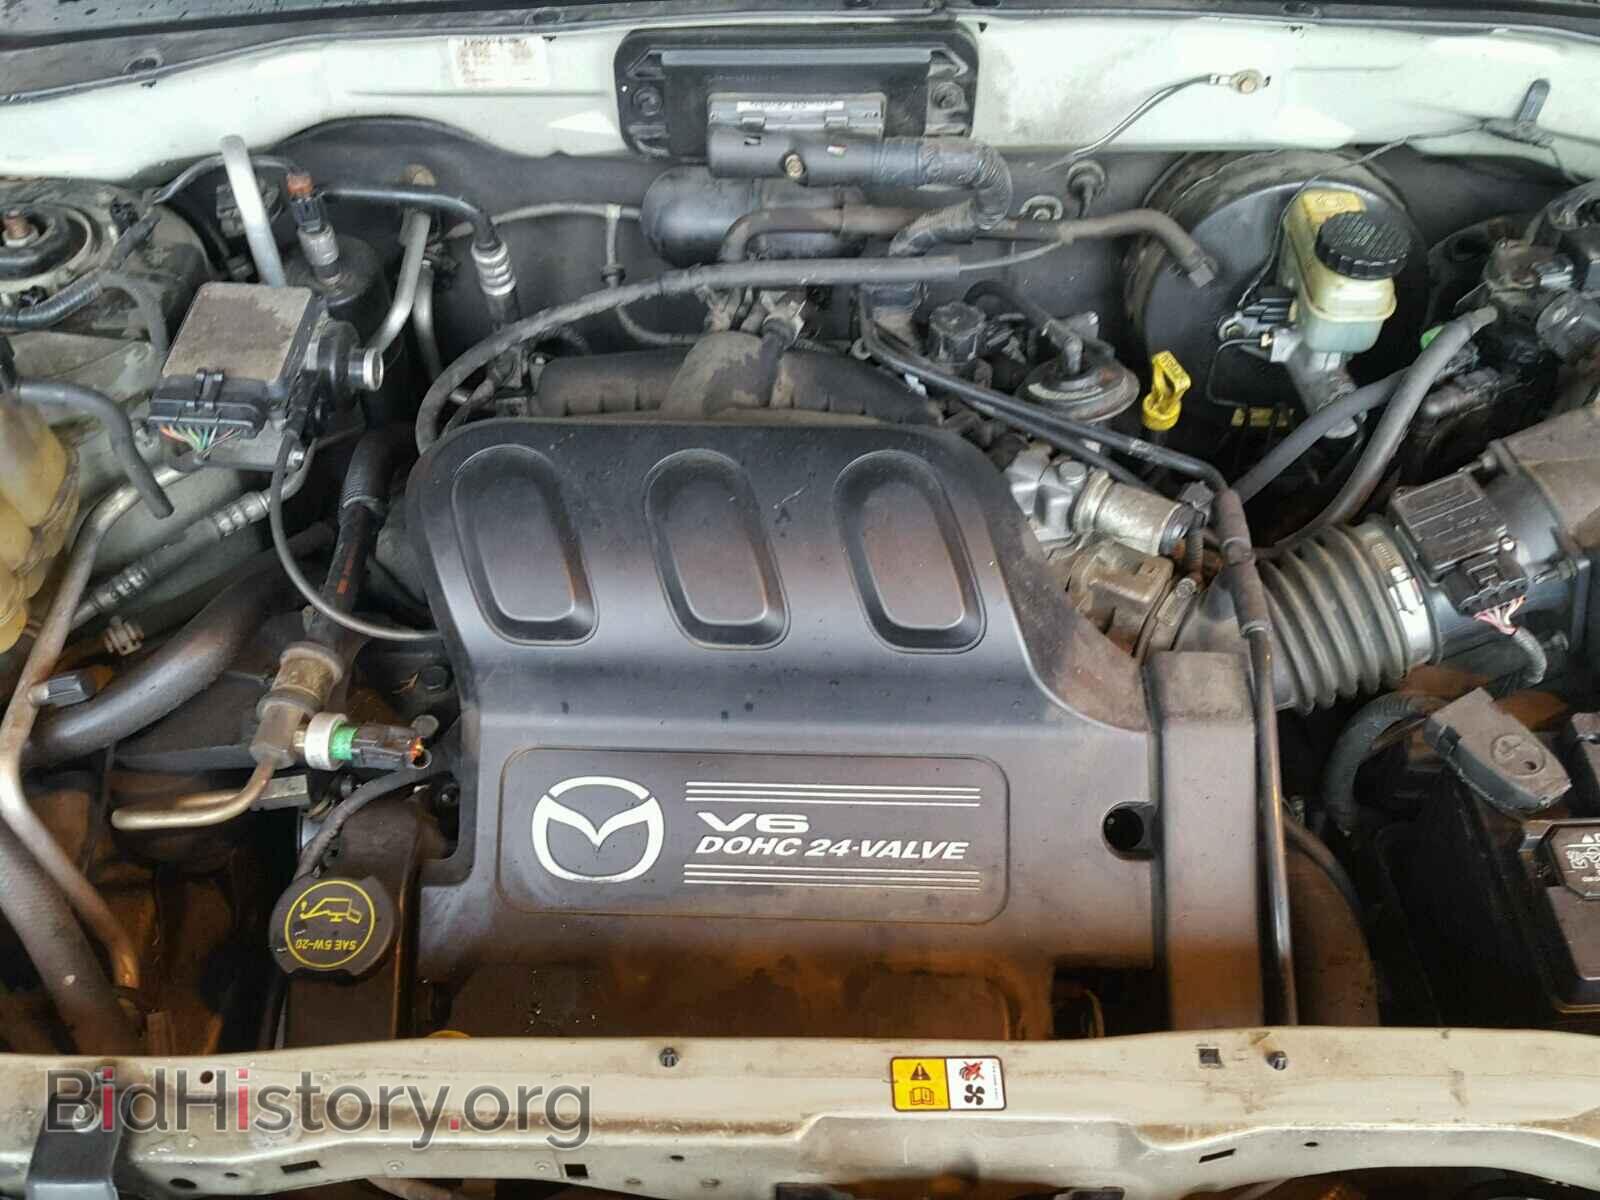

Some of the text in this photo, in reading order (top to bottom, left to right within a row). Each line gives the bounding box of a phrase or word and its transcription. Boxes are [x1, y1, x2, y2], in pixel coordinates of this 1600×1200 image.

[697, 811, 809, 833] V6
[695, 835, 969, 859] DOHC 24-VALVE
[295, 938, 357, 951] SAE 5W-20
